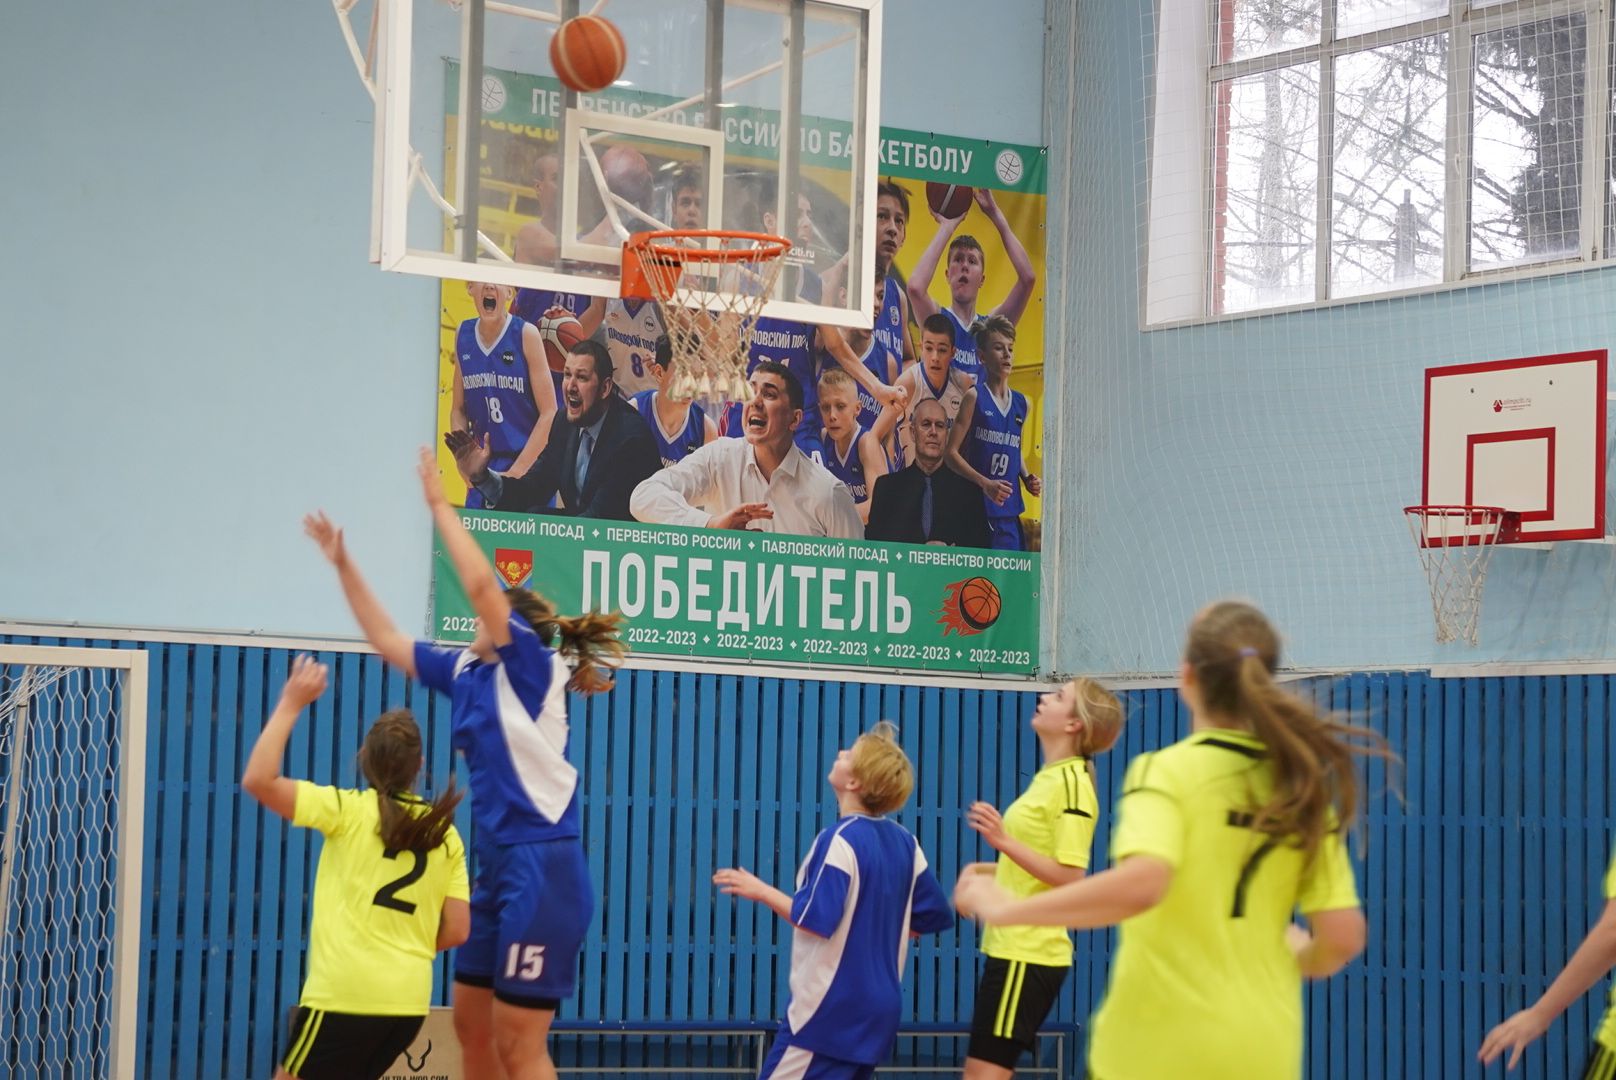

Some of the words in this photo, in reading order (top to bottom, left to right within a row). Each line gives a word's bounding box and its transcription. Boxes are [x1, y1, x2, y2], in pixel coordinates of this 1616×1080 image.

[828, 131, 973, 174] БАКЕТБОЛУ
[631, 353, 645, 378] 8
[540, 522, 585, 541] ПОСАД
[606, 527, 688, 546] ПЕРВЕНСТВО
[692, 534, 741, 550] РОССИИ
[762, 539, 845, 558] ПАВЛОВСКИЙ
[849, 546, 889, 563] ПОСАД
[908, 551, 984, 569] ПЕРВЕНСТВО
[987, 557, 1032, 572] РОССИИ
[582, 549, 912, 635] ПОБЕДИТЕЛЬ
[442, 616, 477, 632] 2022
[628, 627, 697, 646] 2022-2023
[717, 633, 783, 651] 2022-2023
[803, 639, 868, 656] 2022-2023
[887, 643, 951, 661] 2022-2023
[969, 648, 1030, 665] 2022-2023
[372, 846, 428, 916] 2
[504, 942, 546, 981] 15
